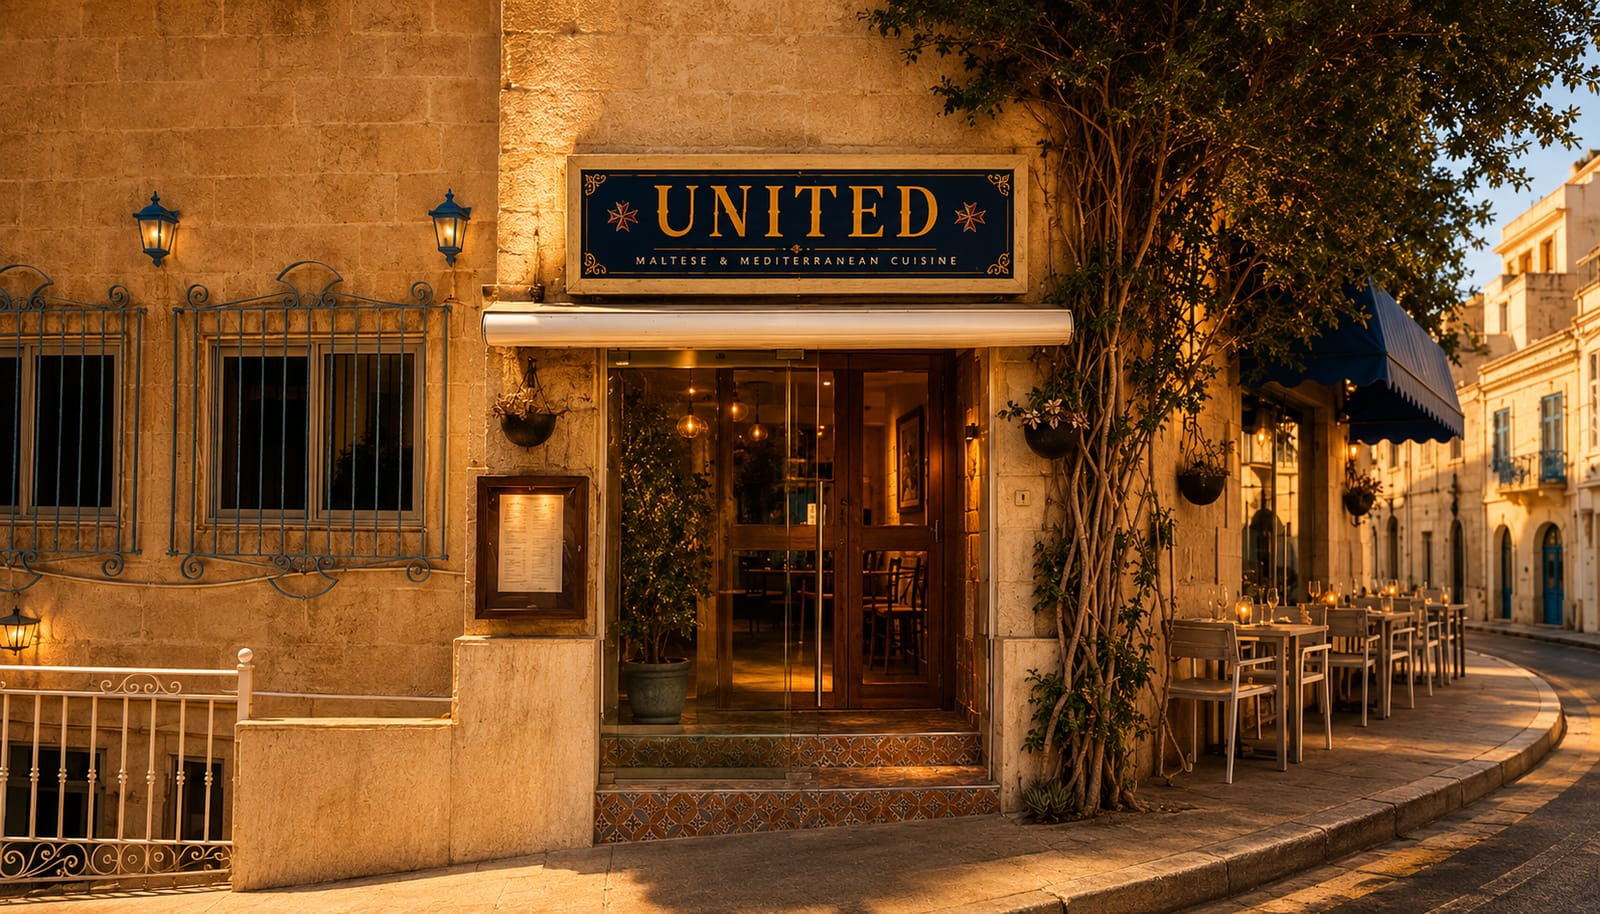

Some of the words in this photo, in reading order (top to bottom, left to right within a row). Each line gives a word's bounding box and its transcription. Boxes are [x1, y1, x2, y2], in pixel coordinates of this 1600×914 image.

[653, 185, 938, 238] UNITED
[635, 256, 707, 266] MALTESE
[719, 256, 728, 266] &
[740, 256, 879, 266] MEDITERRANEAN
[890, 256, 957, 266] CUISINE
